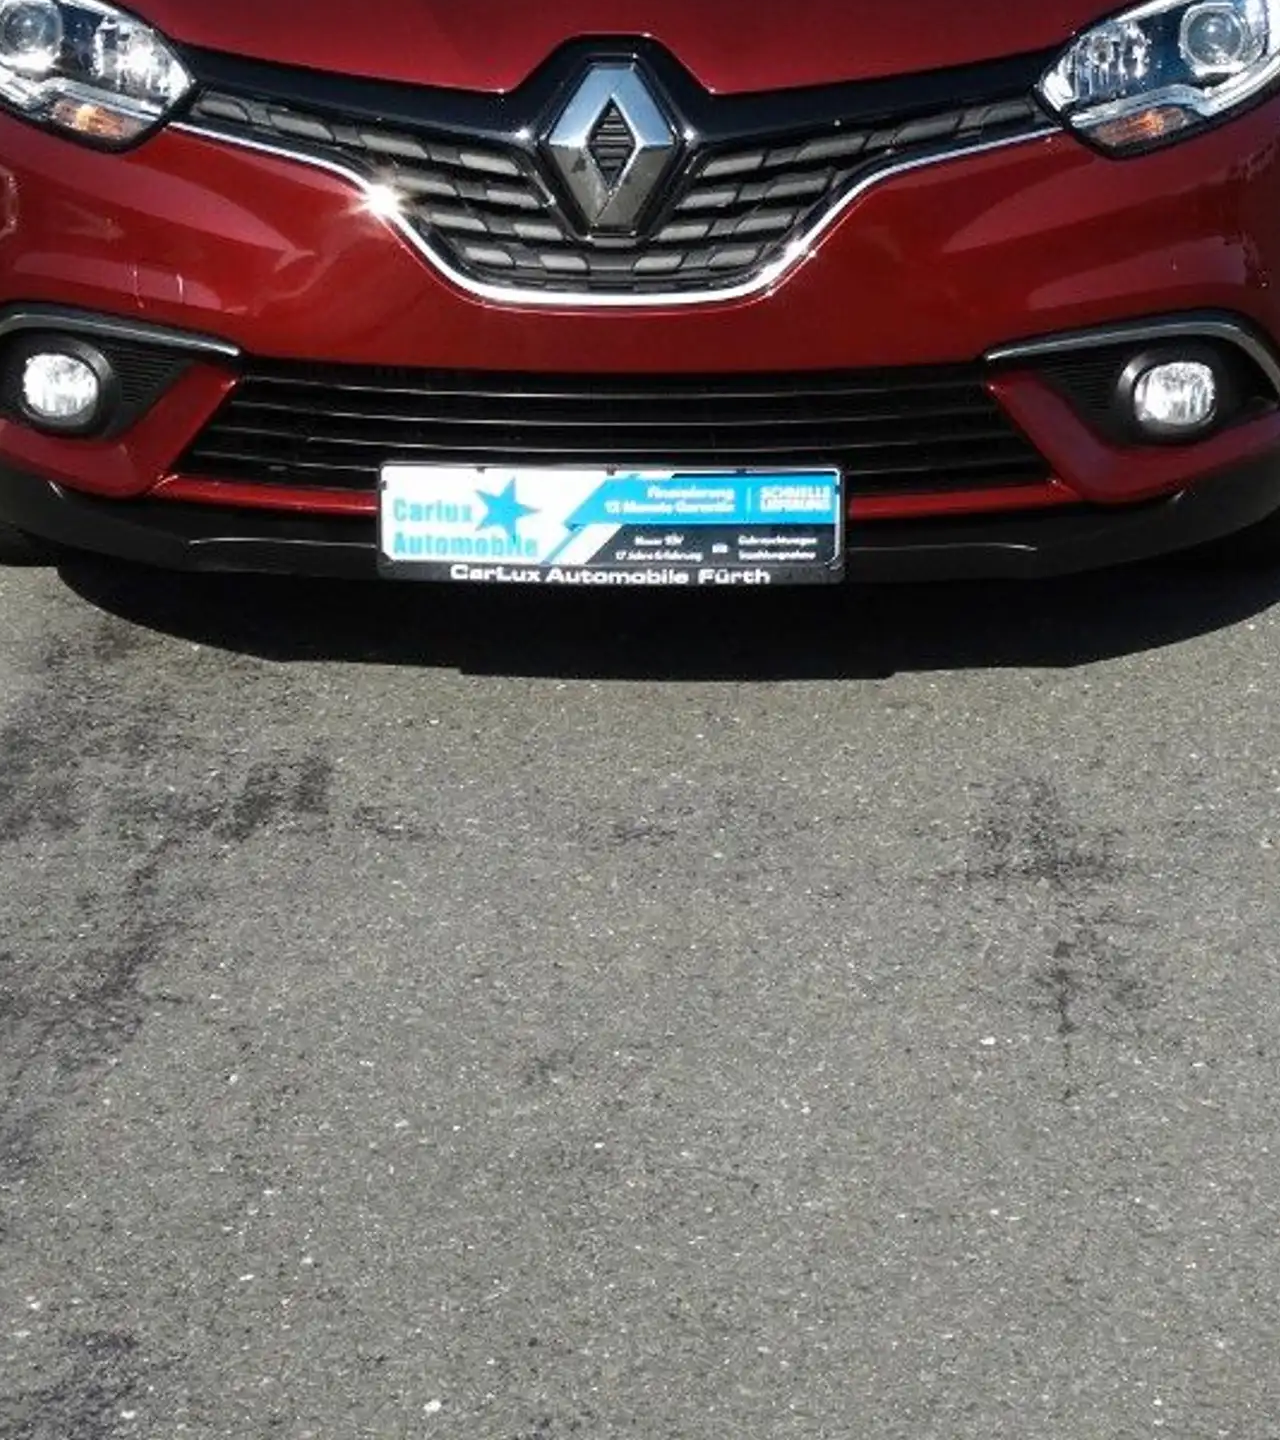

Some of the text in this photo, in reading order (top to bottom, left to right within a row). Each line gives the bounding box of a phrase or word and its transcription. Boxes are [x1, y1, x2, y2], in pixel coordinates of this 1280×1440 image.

[393, 532, 538, 558] Automobile
[450, 563, 770, 585] CarLux Automobile Fürth
